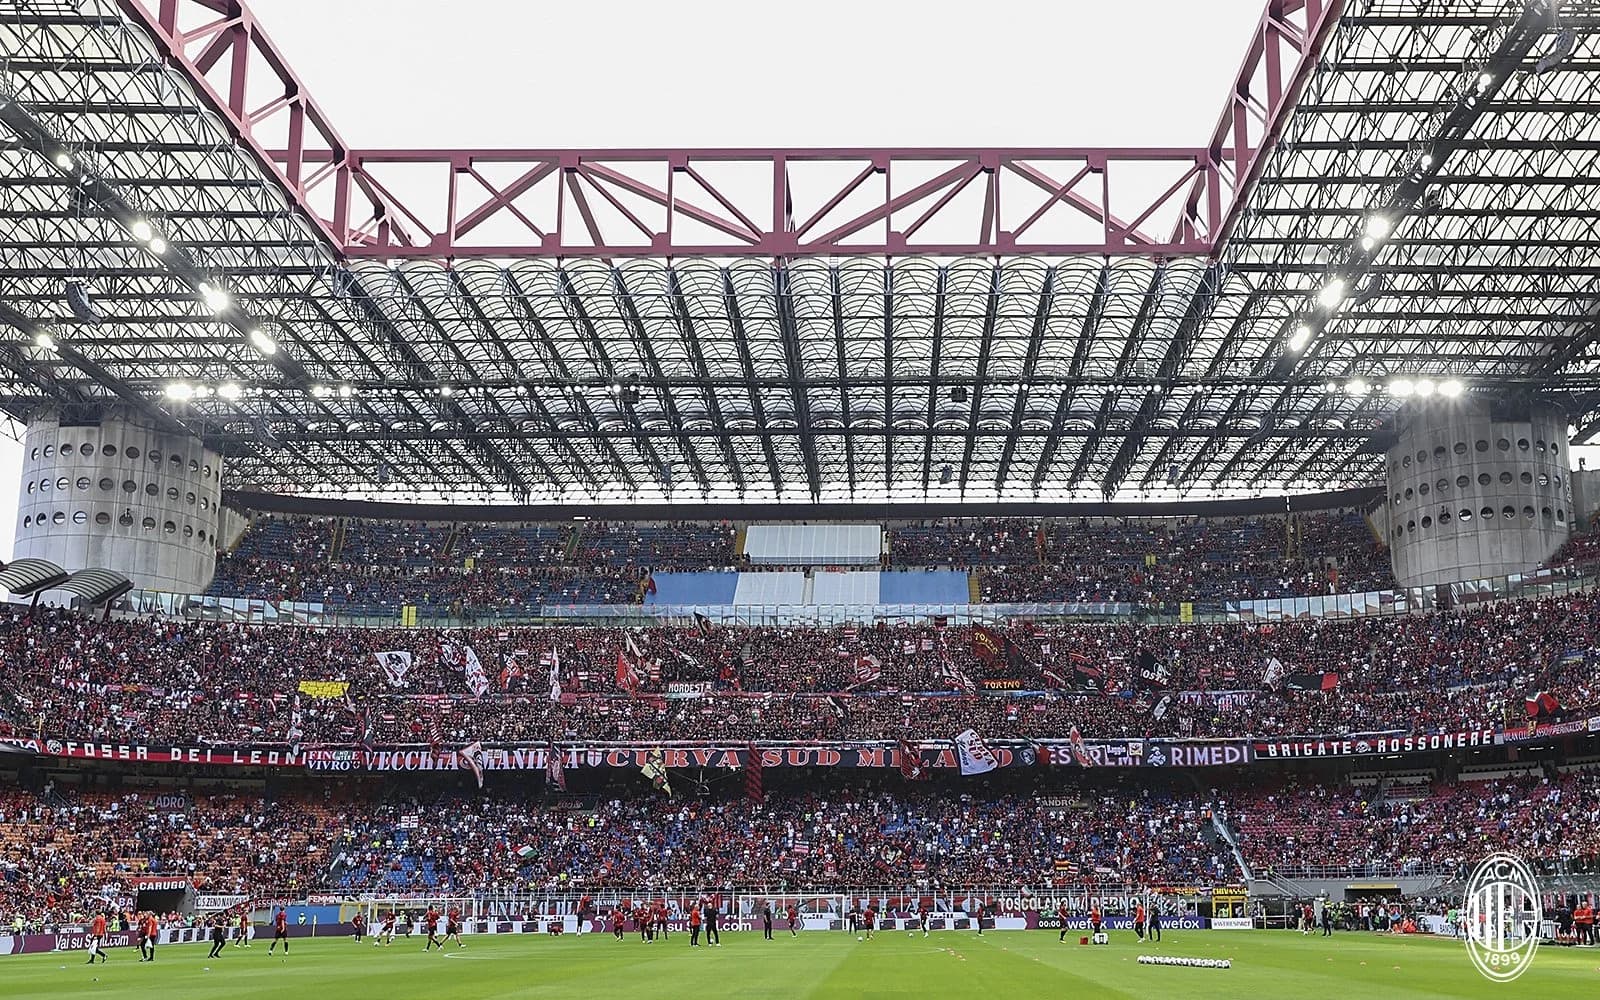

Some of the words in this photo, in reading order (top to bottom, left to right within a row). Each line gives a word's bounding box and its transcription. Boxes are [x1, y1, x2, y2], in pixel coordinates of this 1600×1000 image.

[668, 683, 705, 693] NORDEST
[984, 681, 1020, 689] TORINO
[1267, 741, 1352, 757] BRIGATE
[1377, 729, 1492, 754] ROSSONERE
[66, 742, 148, 760] FOSSA
[170, 747, 212, 762] DEI
[232, 750, 307, 765] LEONI
[761, 749, 841, 767] SUD
[1170, 745, 1249, 767] RIMEDI
[155, 796, 185, 808] ADRO
[139, 881, 185, 891] CARUGO
[667, 923, 682, 932] su
[1160, 918, 1199, 929] wefox
[55, 935, 70, 949] Vai
[71, 938, 82, 949] su
